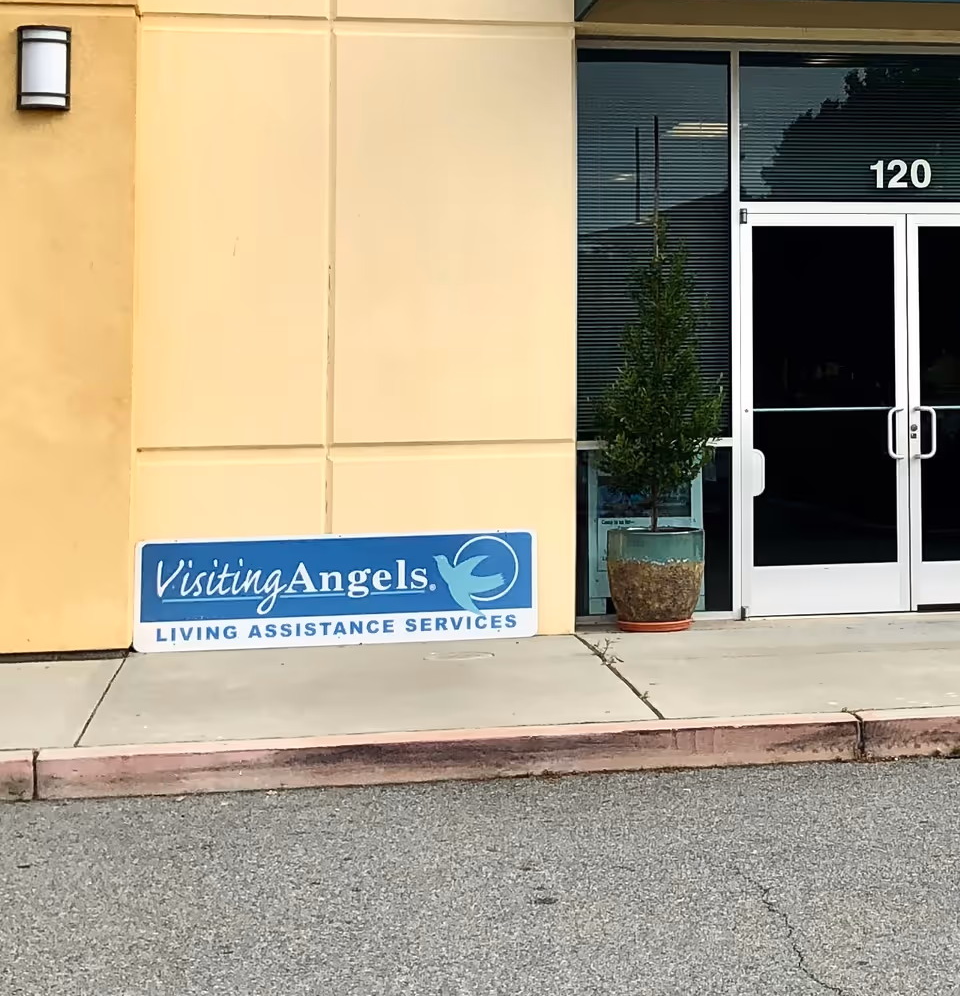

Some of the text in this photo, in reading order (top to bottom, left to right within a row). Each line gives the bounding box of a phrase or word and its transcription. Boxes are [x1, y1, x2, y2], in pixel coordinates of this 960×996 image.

[869, 159, 932, 190] 120
[156, 558, 289, 615] Visiting
[156, 613, 518, 642] LIVING ASSISTANCE SERVICES
